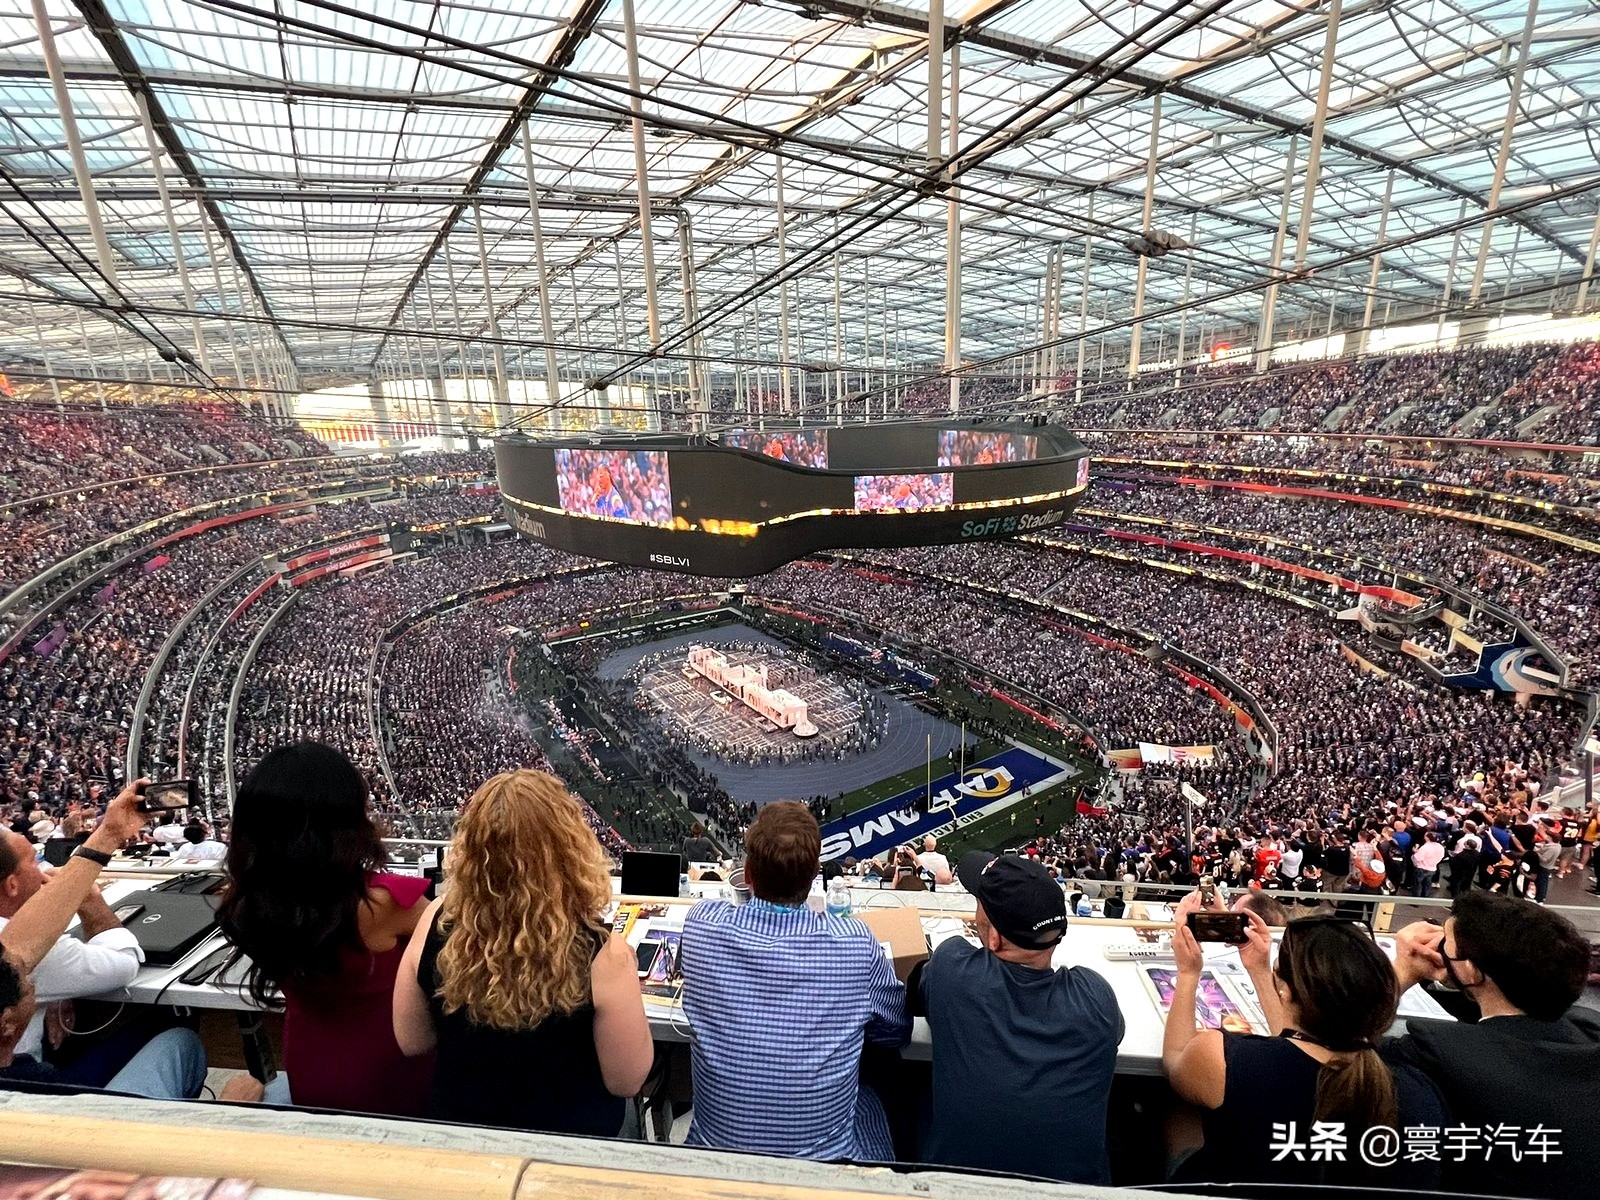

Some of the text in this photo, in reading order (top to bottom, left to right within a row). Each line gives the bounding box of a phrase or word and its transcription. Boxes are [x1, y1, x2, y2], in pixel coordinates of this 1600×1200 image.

[961, 509, 1064, 537] SoFi Stadium
[330, 542, 361, 554] BENGALS
[650, 554, 690, 567] #SBLVI
[961, 810, 984, 824] END
[1212, 865, 1222, 878] 81
